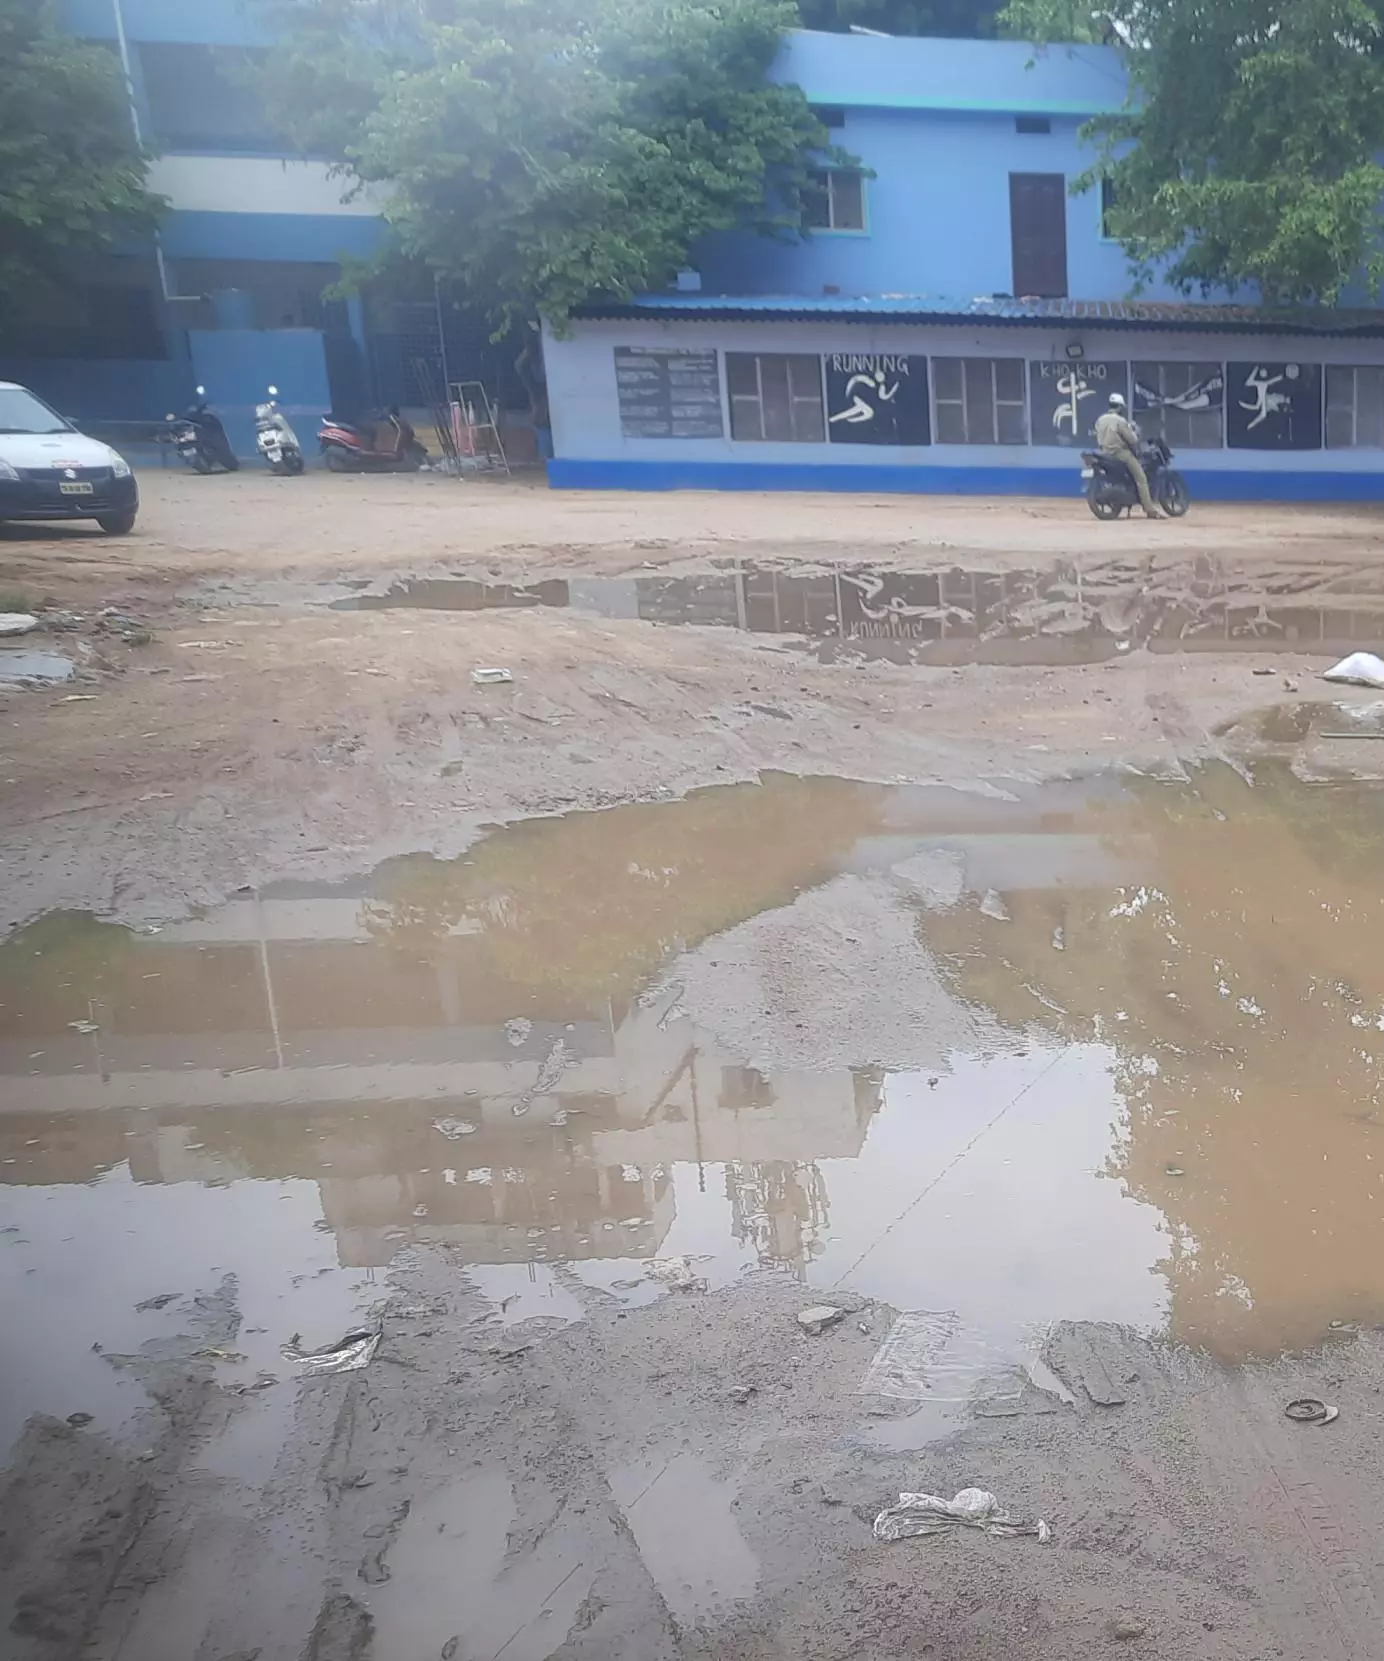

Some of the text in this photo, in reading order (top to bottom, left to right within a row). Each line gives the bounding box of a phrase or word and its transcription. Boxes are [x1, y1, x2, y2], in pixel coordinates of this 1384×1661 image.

[832, 353, 910, 377] RUNNING
[1040, 361, 1107, 380] KHO KHO
